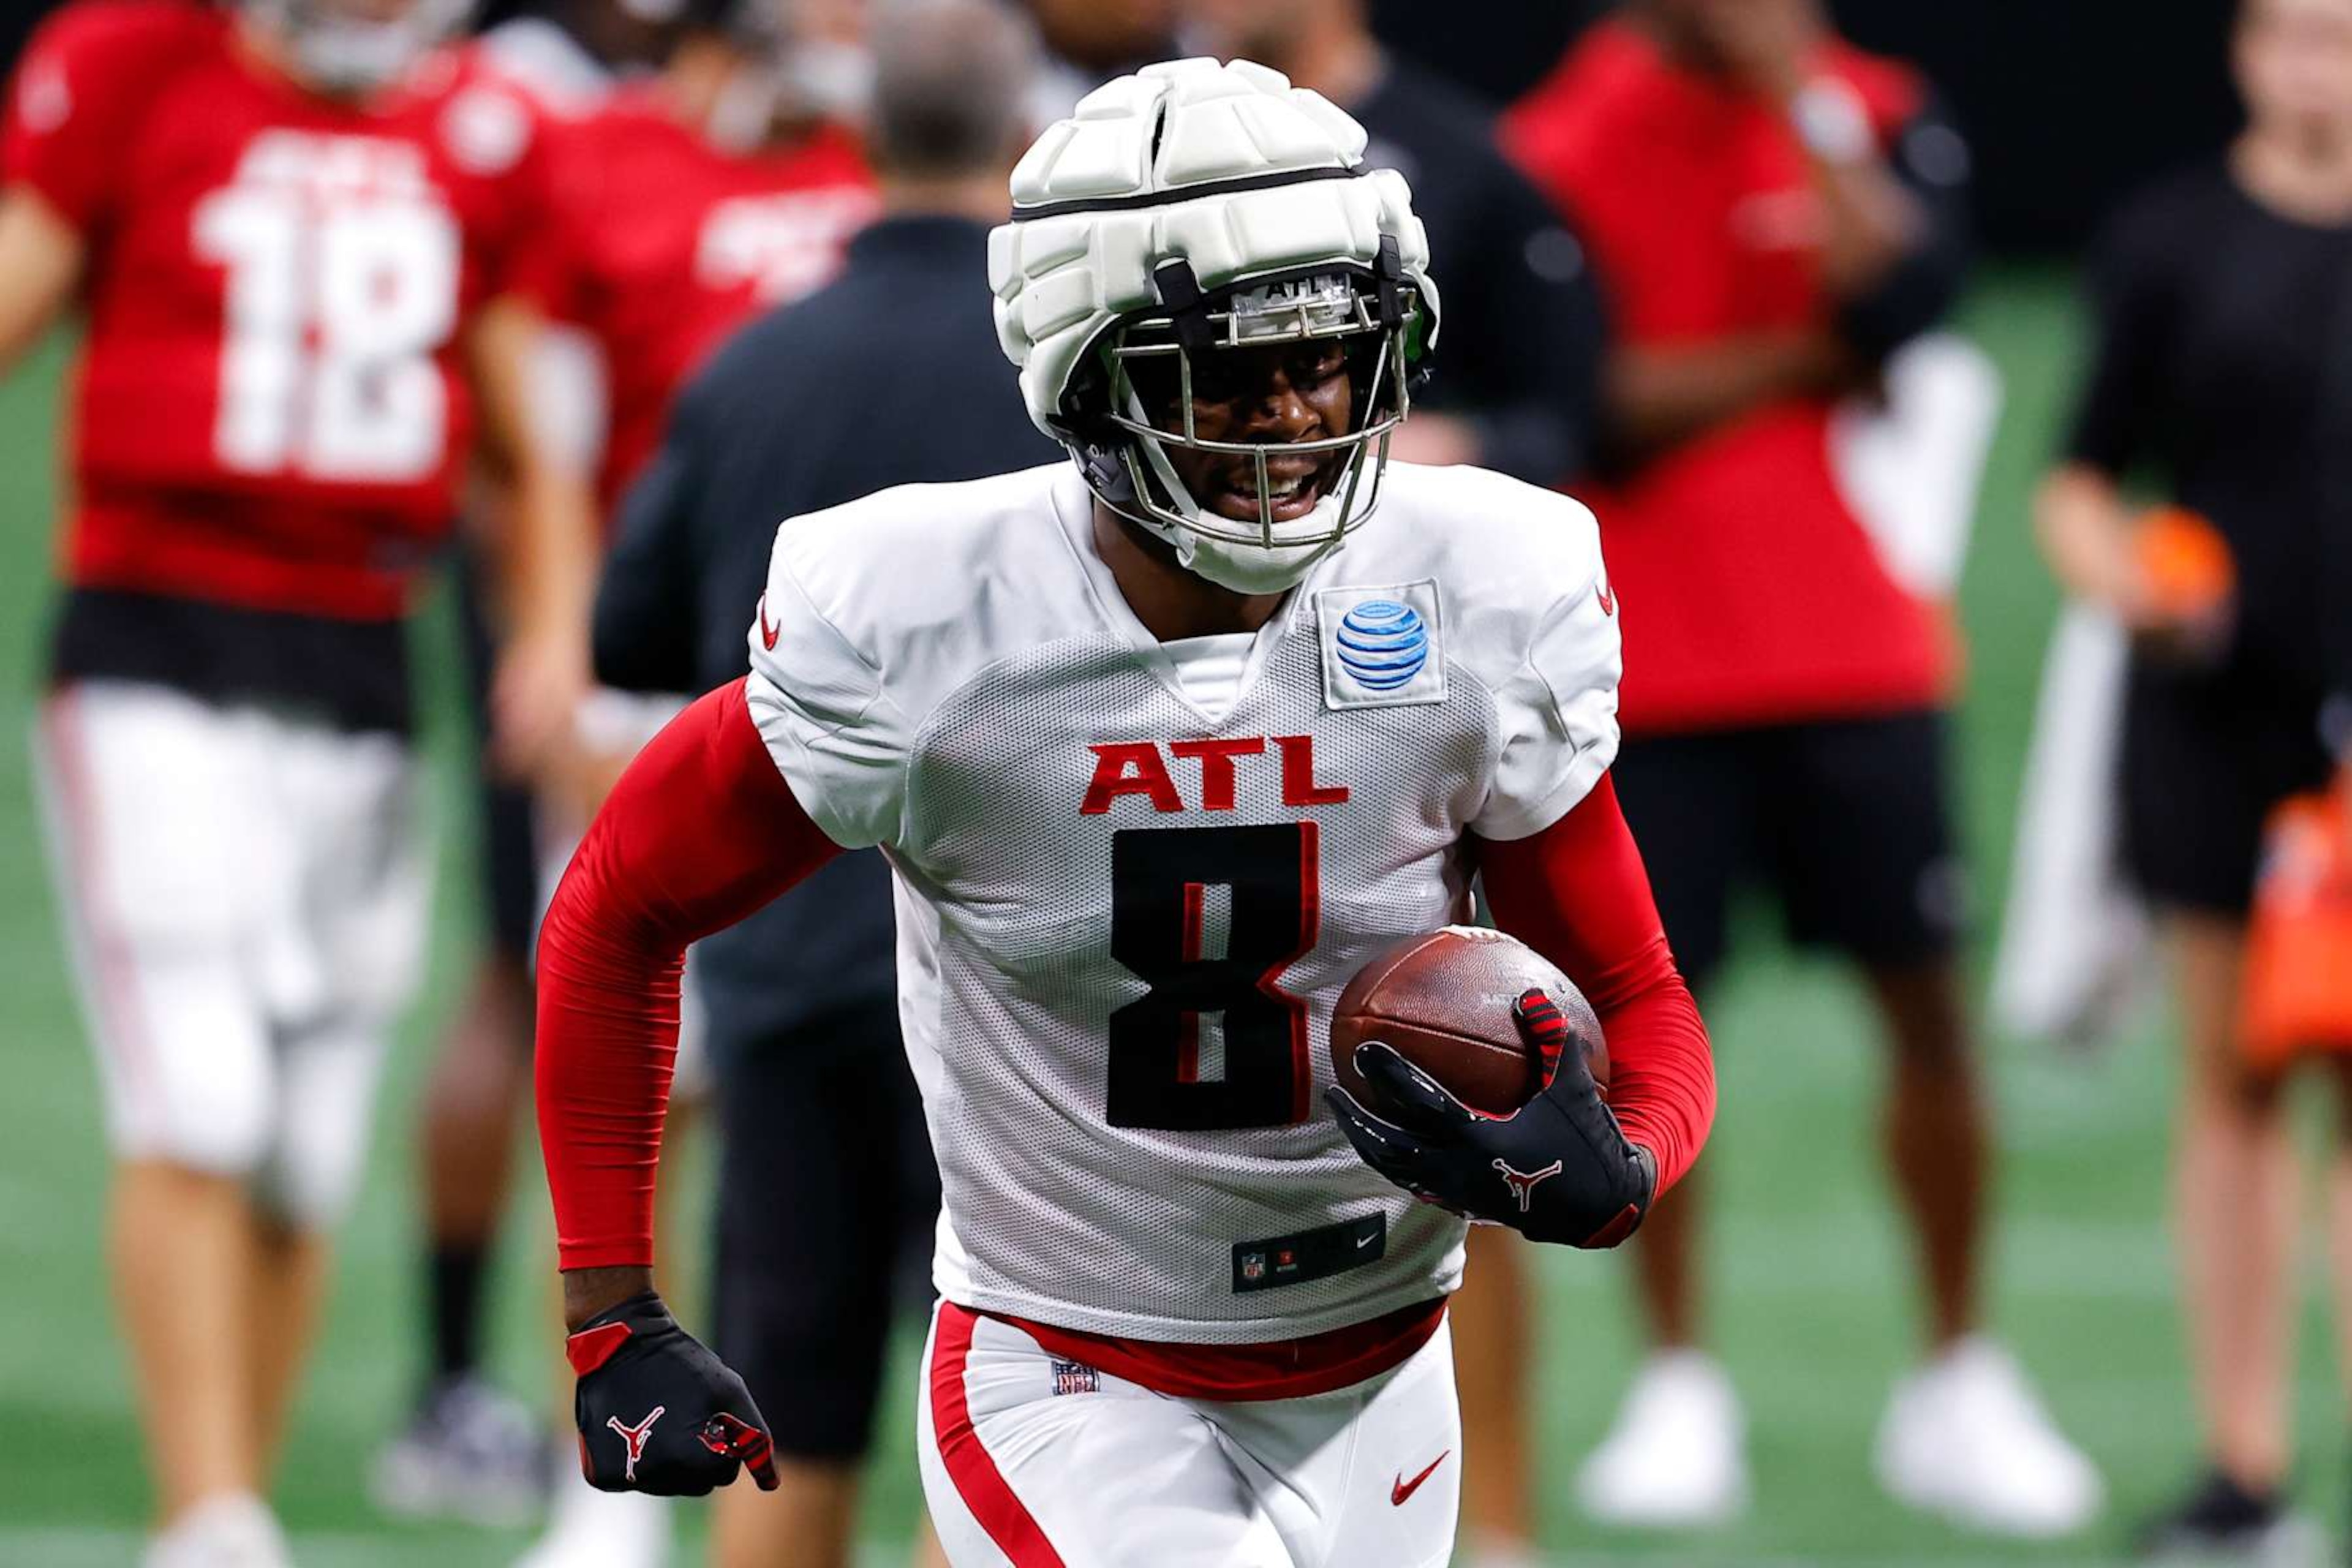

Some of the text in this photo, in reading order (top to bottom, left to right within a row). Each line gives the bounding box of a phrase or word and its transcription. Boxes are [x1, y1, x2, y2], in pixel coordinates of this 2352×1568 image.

[1265, 276, 1321, 299] ATL
[189, 187, 462, 482] 18
[1079, 735, 1351, 815] ATL
[1107, 820, 1320, 1132] 8
[1058, 1373, 1095, 1395] NFL
